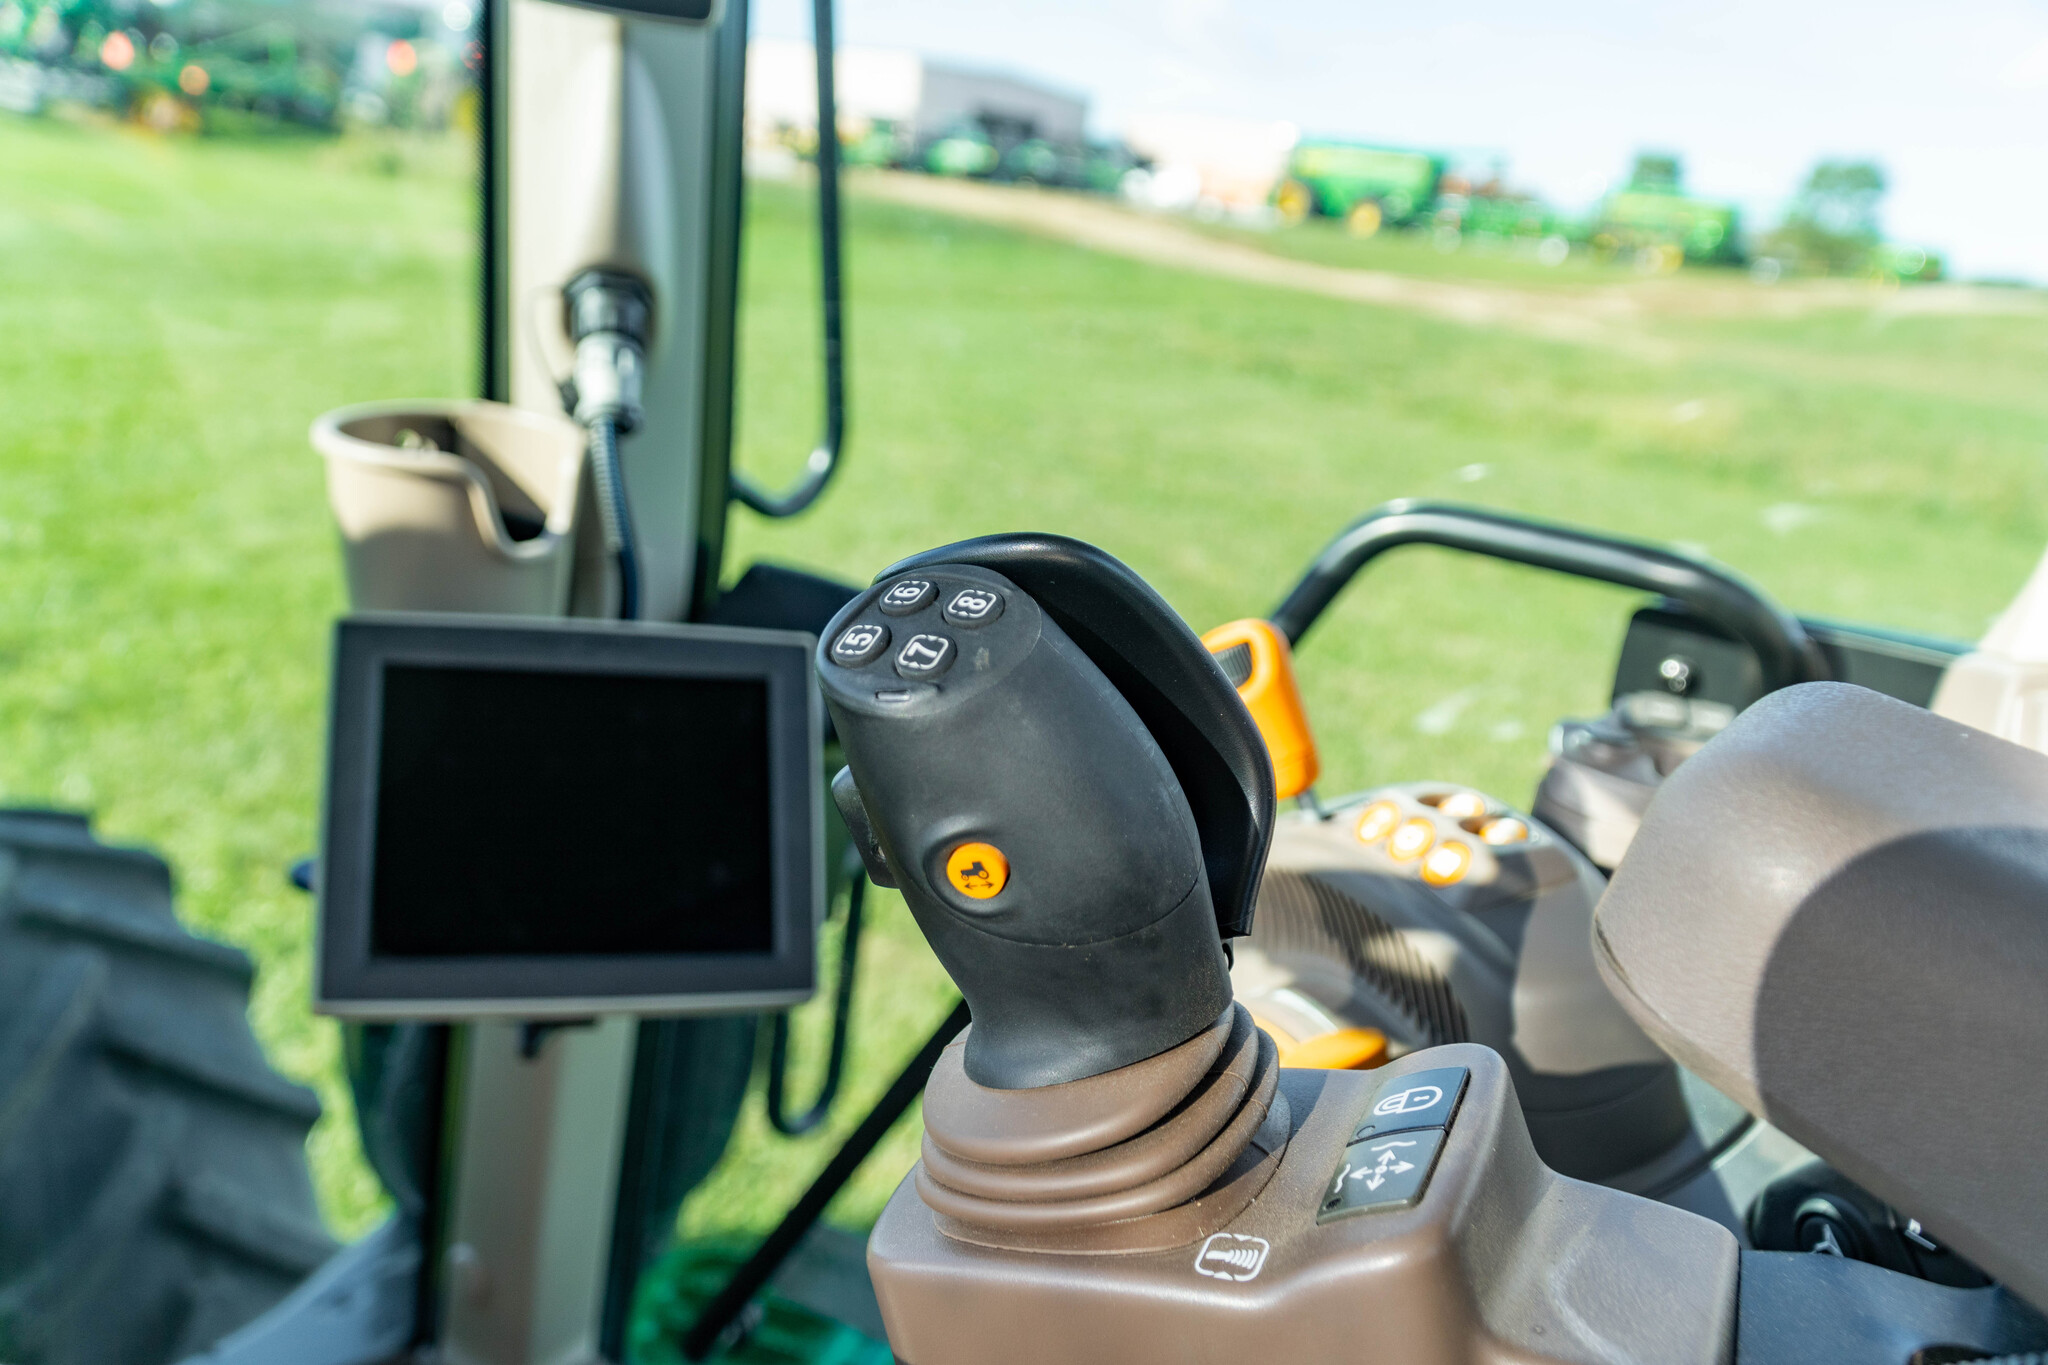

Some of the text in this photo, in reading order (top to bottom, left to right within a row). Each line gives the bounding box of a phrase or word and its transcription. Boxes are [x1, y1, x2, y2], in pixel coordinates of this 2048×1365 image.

[894, 586, 921, 598] 6
[957, 597, 987, 610] 8
[846, 632, 874, 647] 5
[907, 642, 938, 658] 7
